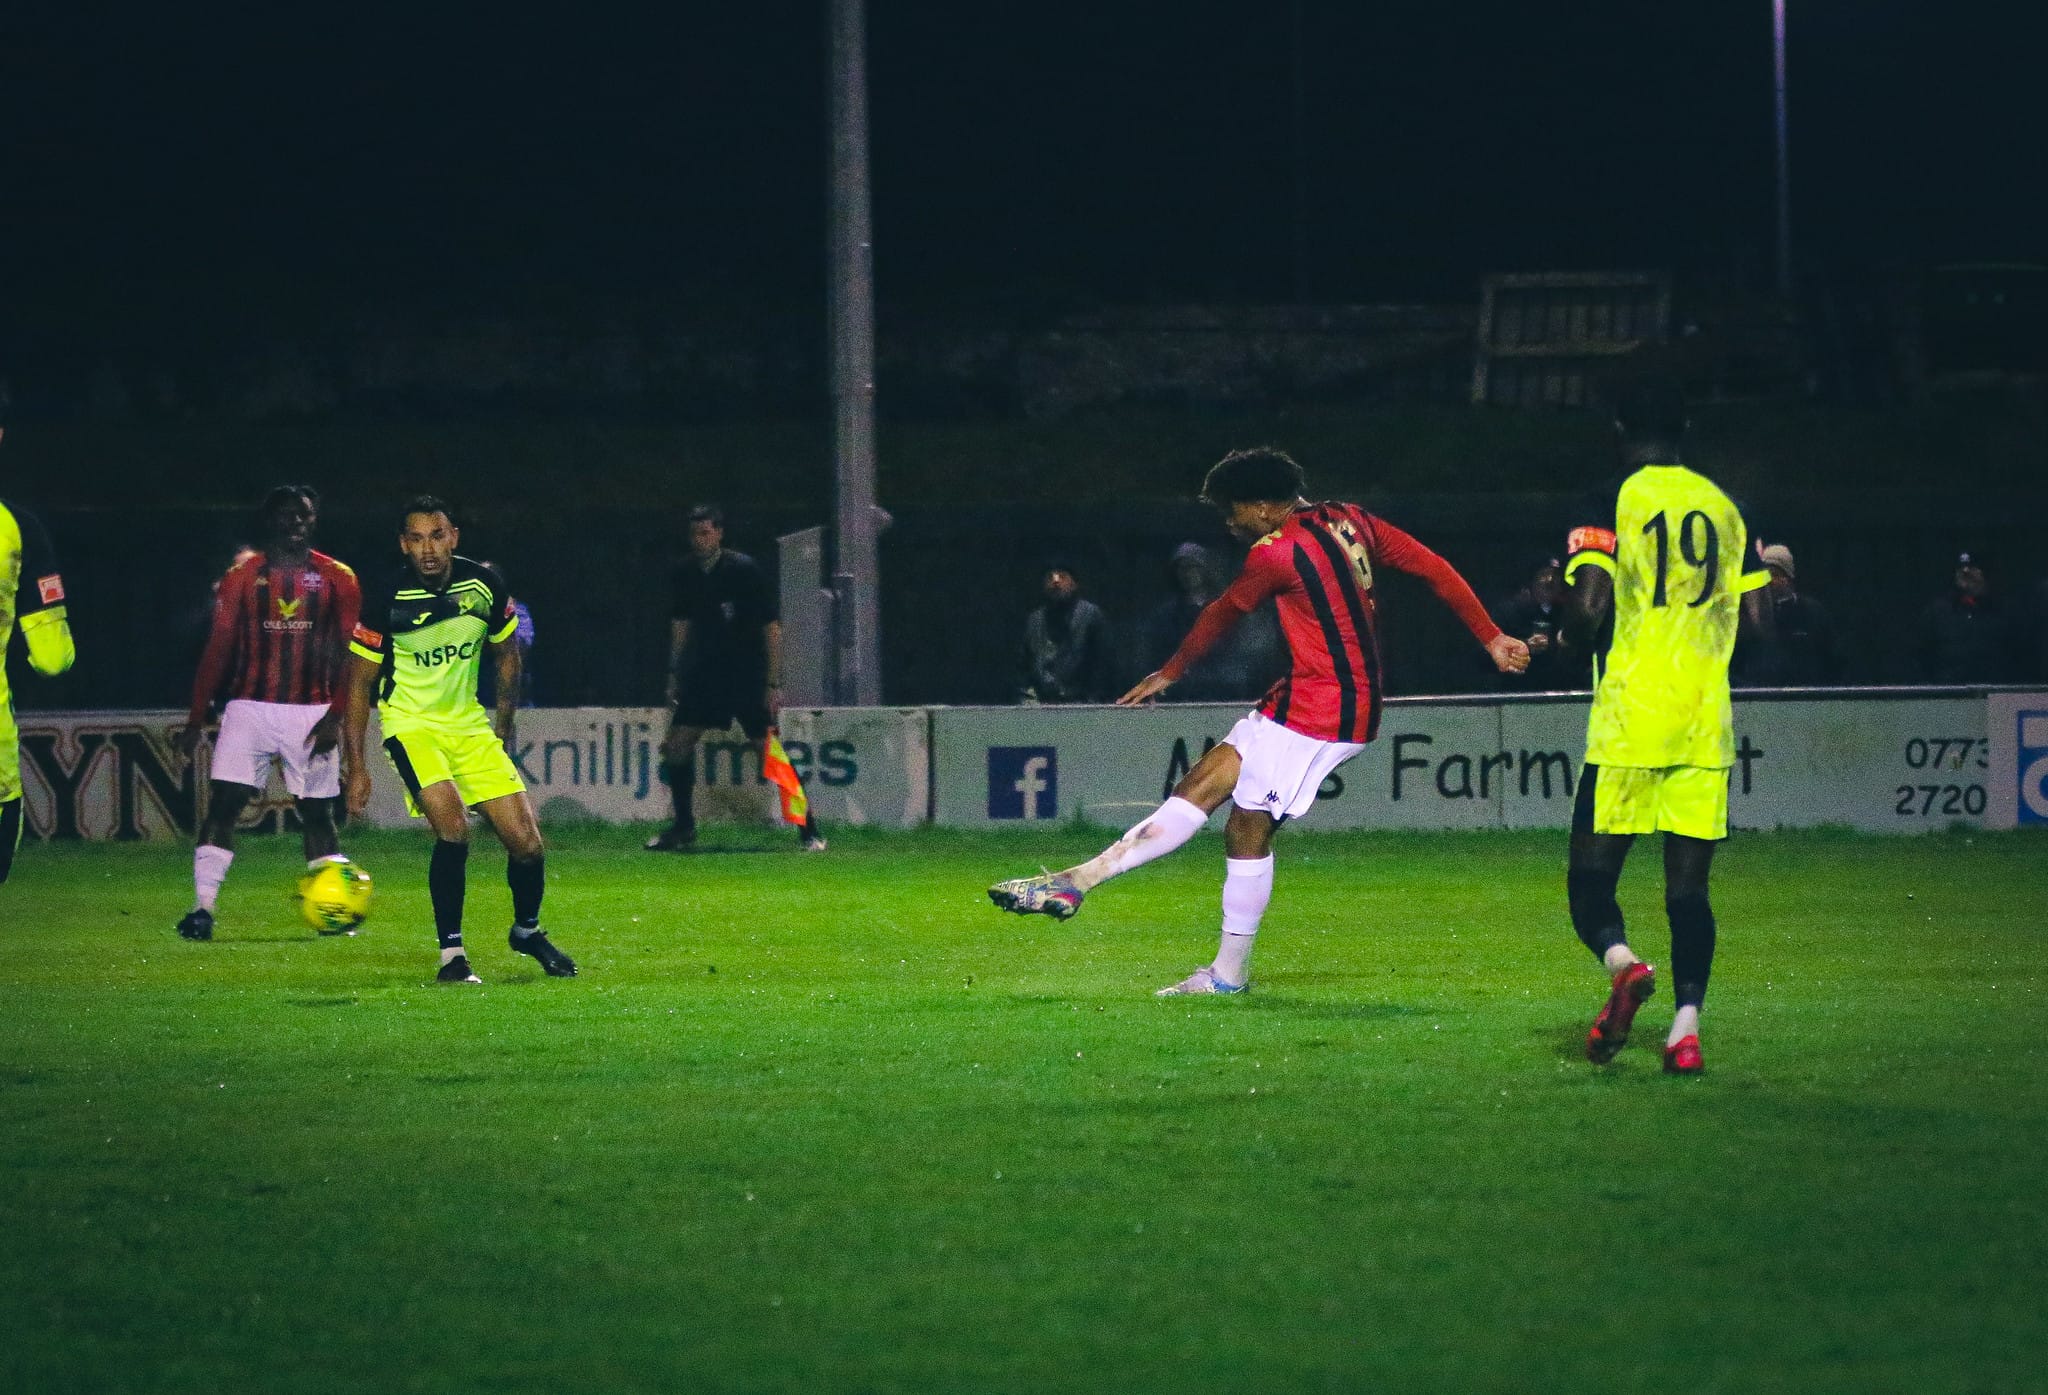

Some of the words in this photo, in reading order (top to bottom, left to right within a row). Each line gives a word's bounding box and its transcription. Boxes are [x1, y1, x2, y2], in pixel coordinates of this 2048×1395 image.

[1643, 510, 1718, 607] 19
[414, 637, 482, 667] NSPC
[507, 723, 858, 799] knilljmes
[1895, 784, 1987, 816] 2720
